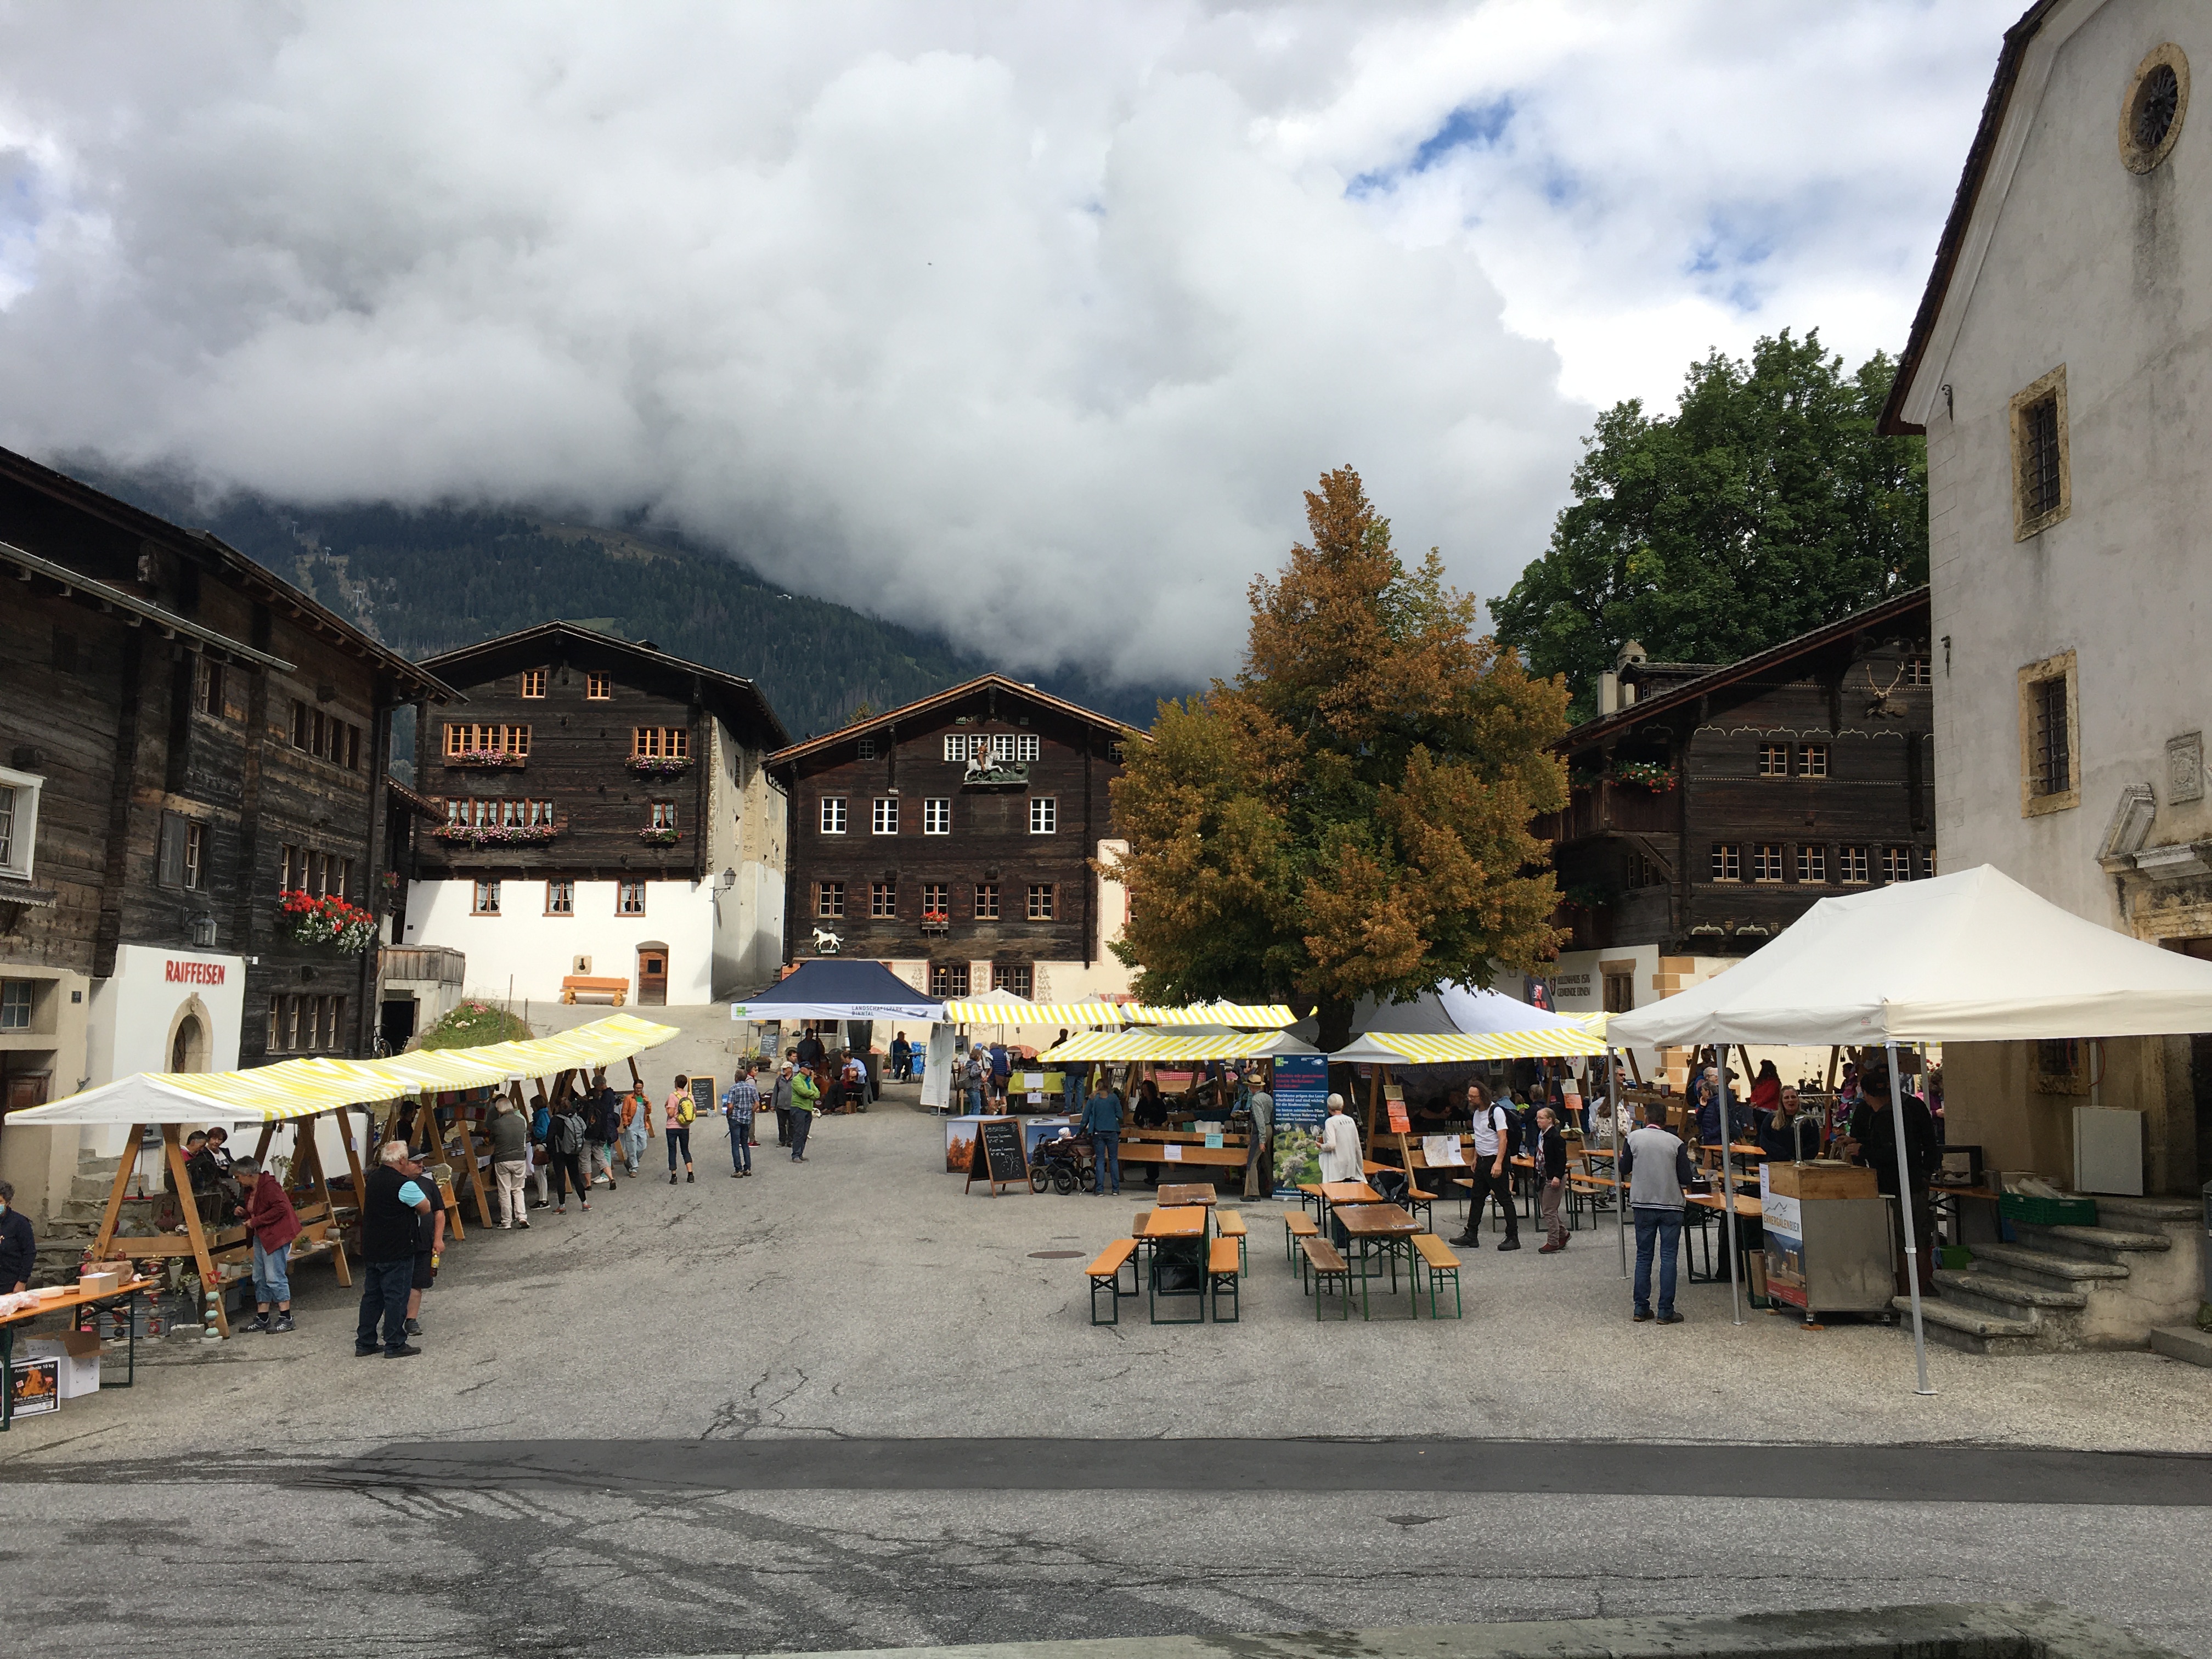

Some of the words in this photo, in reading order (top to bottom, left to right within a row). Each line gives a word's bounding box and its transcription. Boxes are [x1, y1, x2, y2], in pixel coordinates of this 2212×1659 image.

[166, 960, 225, 985] RAIFFEISEN
[1425, 1064, 1451, 1075] Veglia
[1453, 1063, 1485, 1071] Devero
[1763, 1213, 1801, 1233] ERNERGALENBIER
